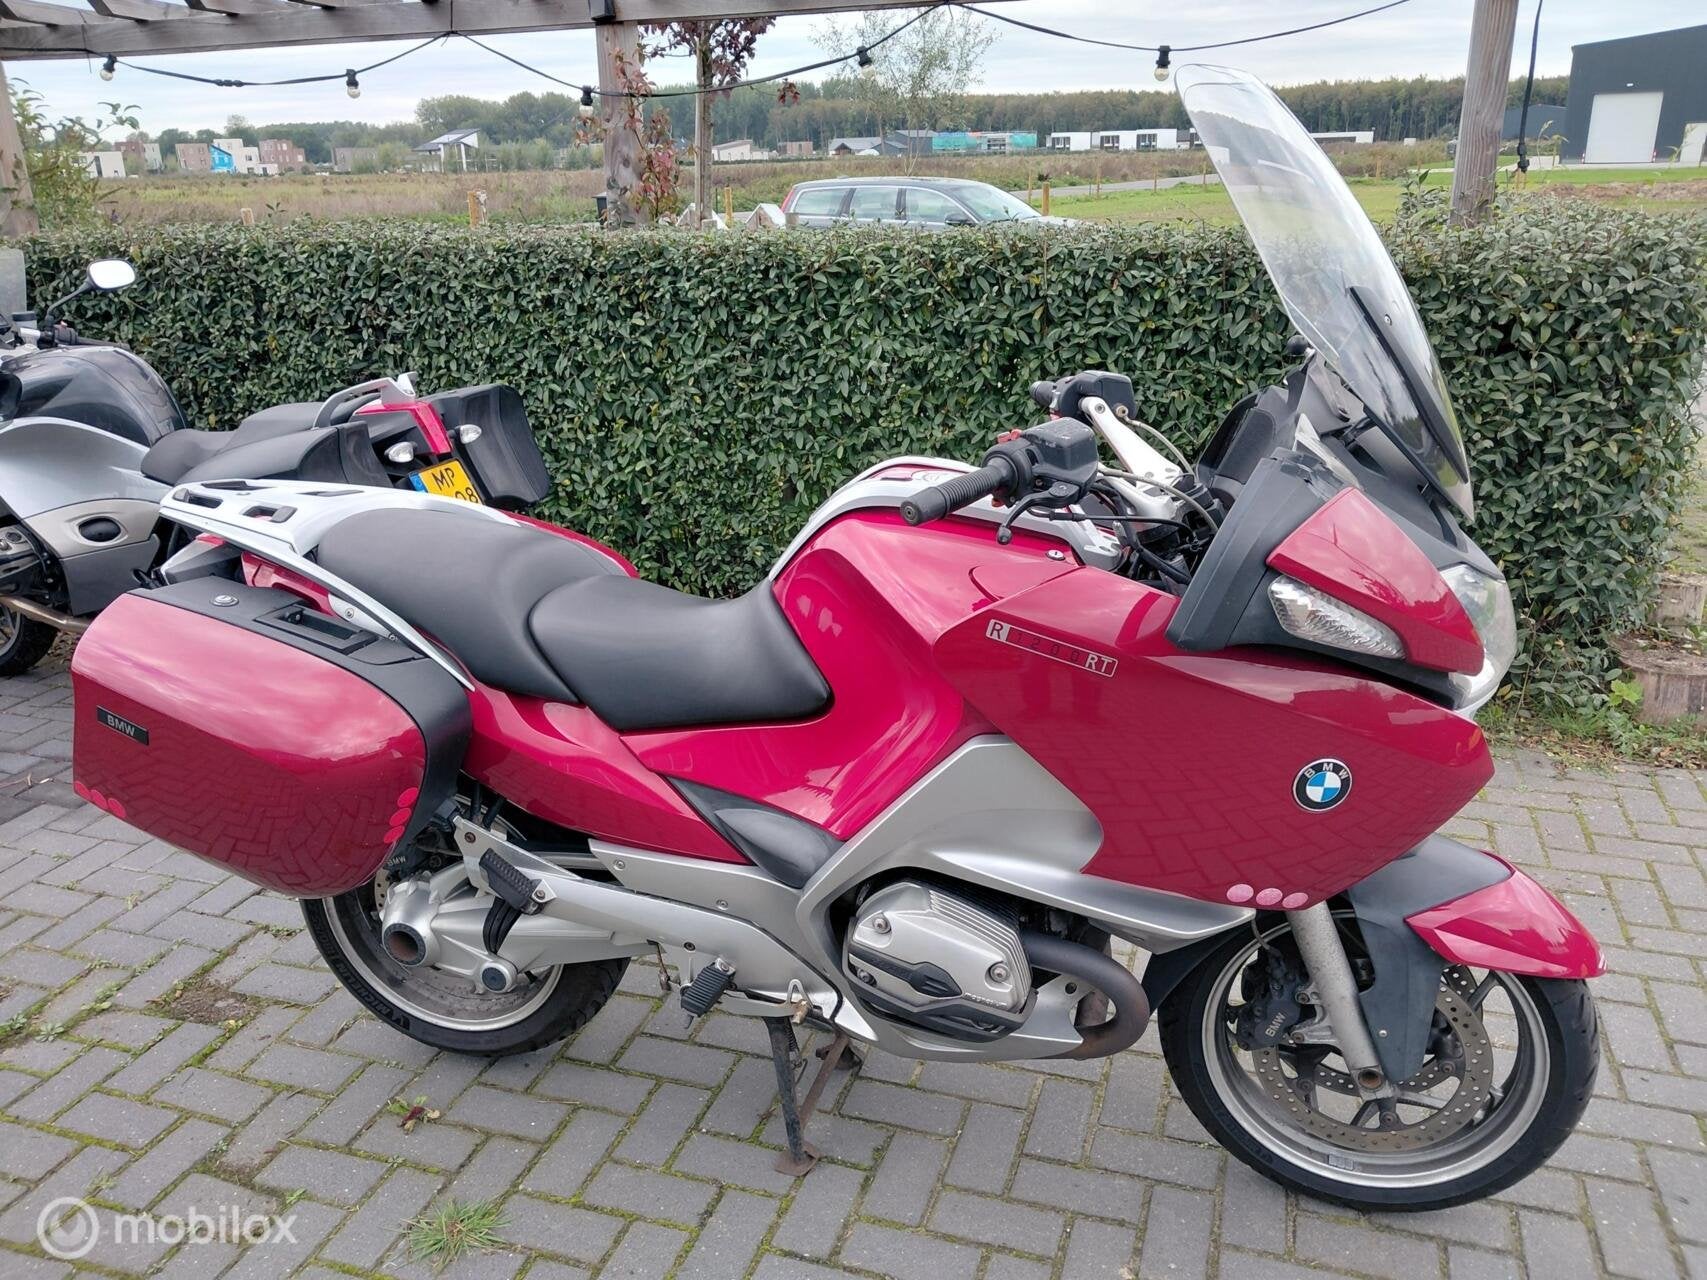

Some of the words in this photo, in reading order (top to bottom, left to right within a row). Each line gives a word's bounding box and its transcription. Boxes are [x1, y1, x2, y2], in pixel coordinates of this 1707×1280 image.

[431, 467, 455, 491] MP
[989, 621, 1004, 640] R
[1084, 653, 1113, 673] RT
[107, 714, 135, 737] BMW
[1304, 762, 1349, 780] BMW
[1265, 1012, 1286, 1037] BMW
